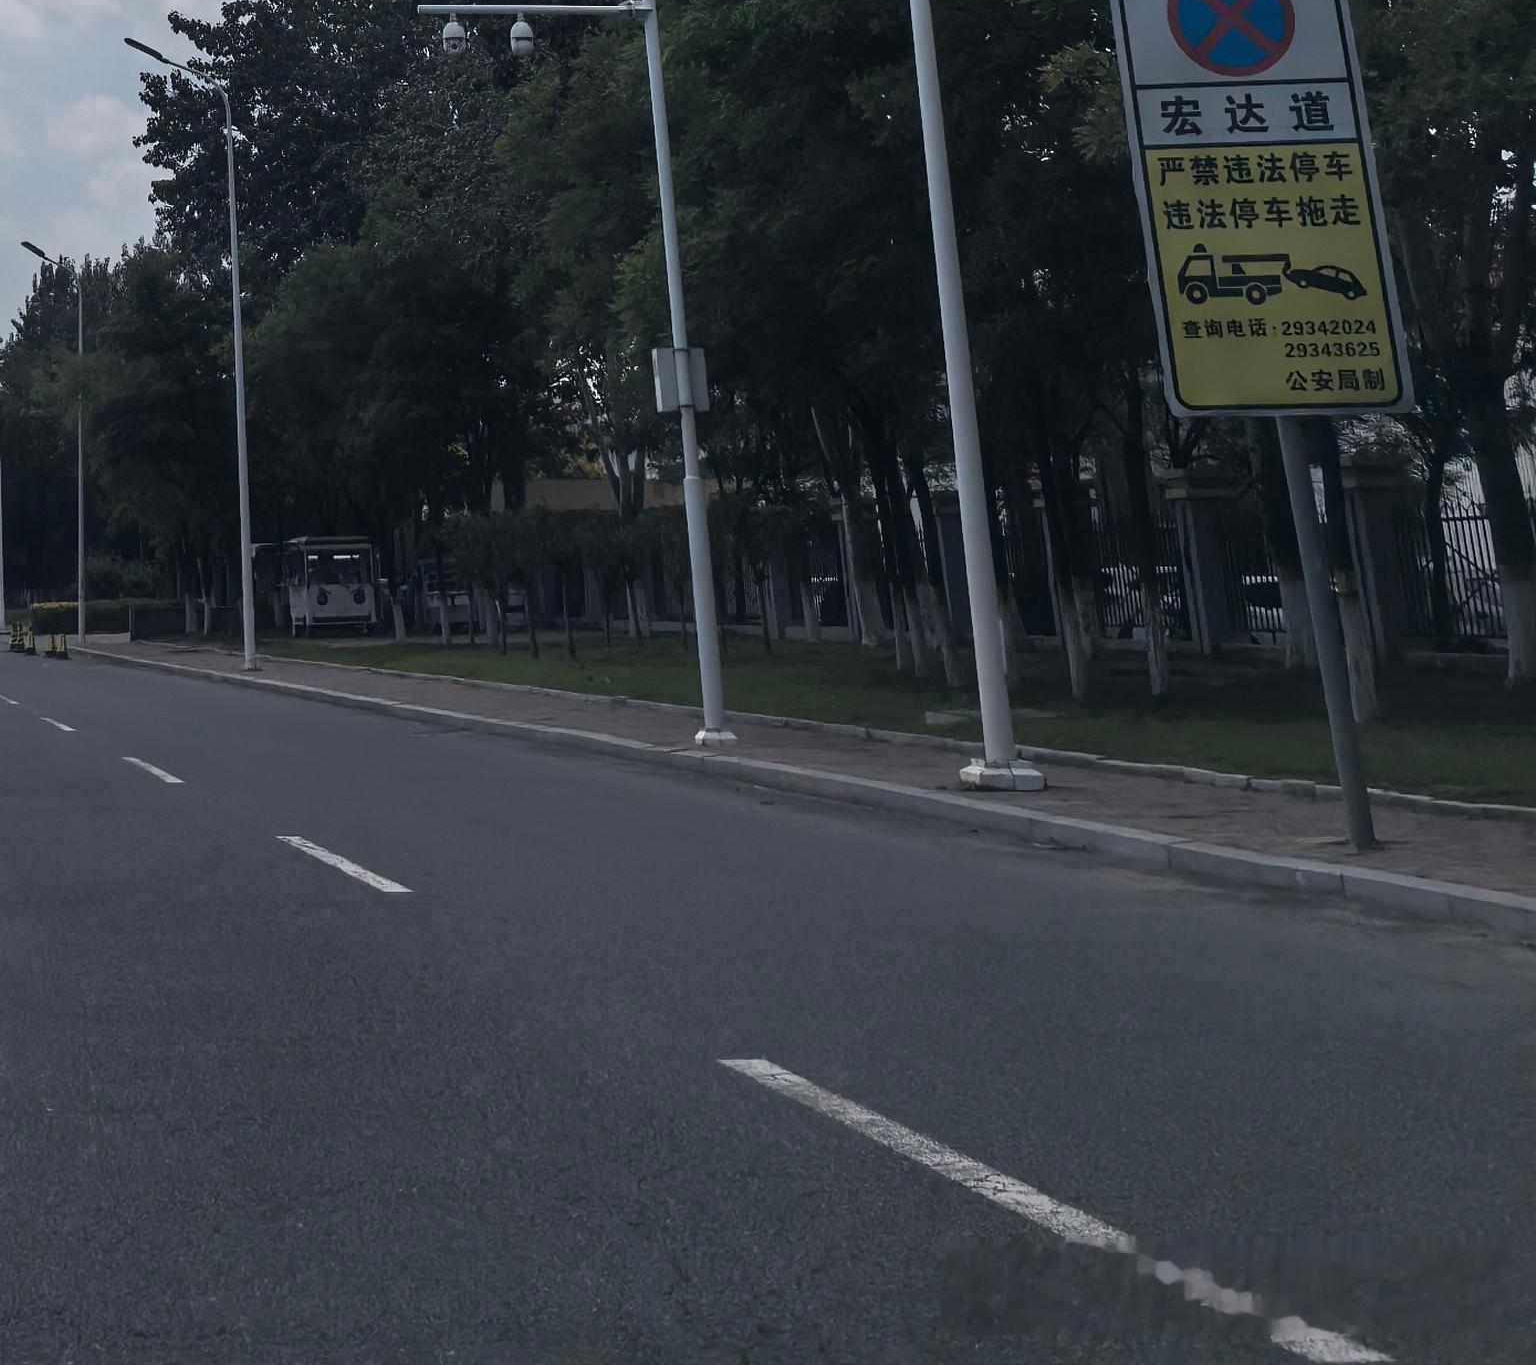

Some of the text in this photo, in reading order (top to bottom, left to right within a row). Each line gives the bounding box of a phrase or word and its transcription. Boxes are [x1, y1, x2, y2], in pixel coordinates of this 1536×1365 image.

[1160, 90, 1335, 136] 宏达道
[1157, 151, 1353, 186] 严禁违法停车
[1163, 194, 1362, 230] 违法停车拖走
[1284, 342, 1381, 358] 29343625
[1286, 369, 1385, 391] 公安局制
